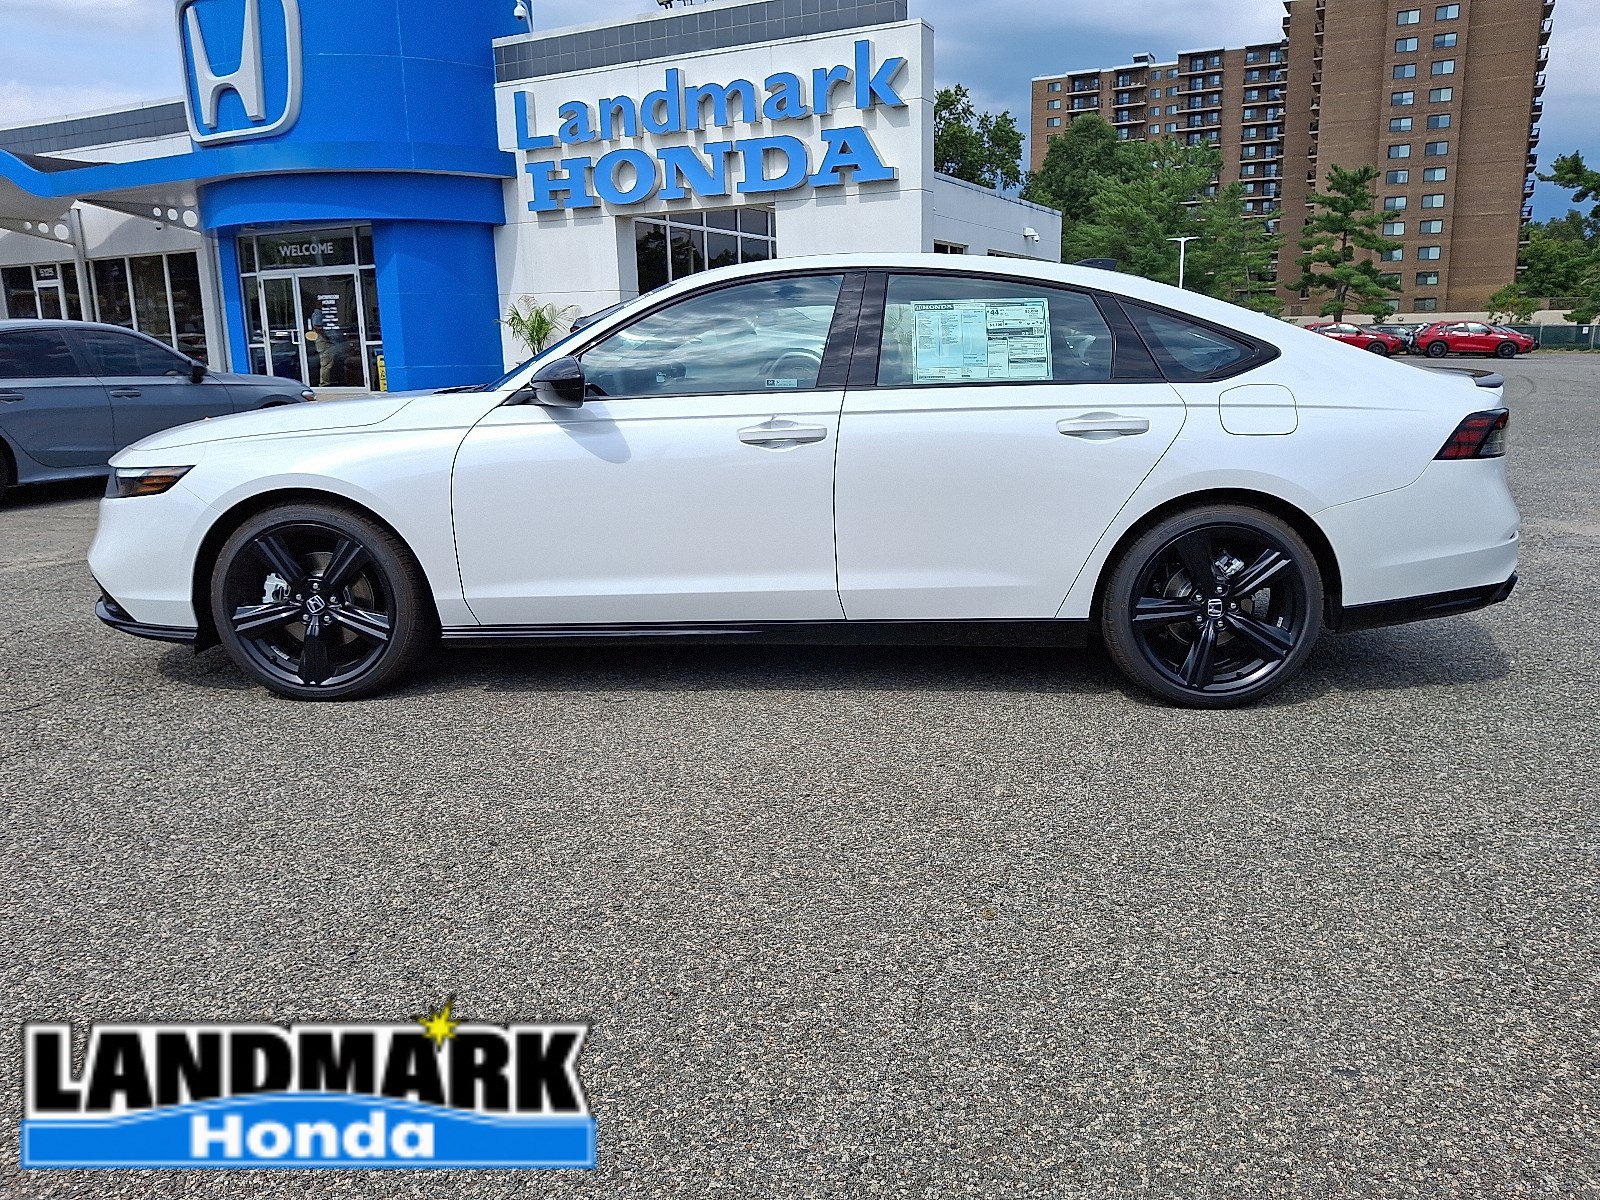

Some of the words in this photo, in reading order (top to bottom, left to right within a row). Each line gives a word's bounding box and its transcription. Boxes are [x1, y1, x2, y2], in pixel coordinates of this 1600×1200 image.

[513, 39, 908, 151] Landmark
[525, 126, 899, 212] HONDA
[279, 242, 334, 257] WELCOME
